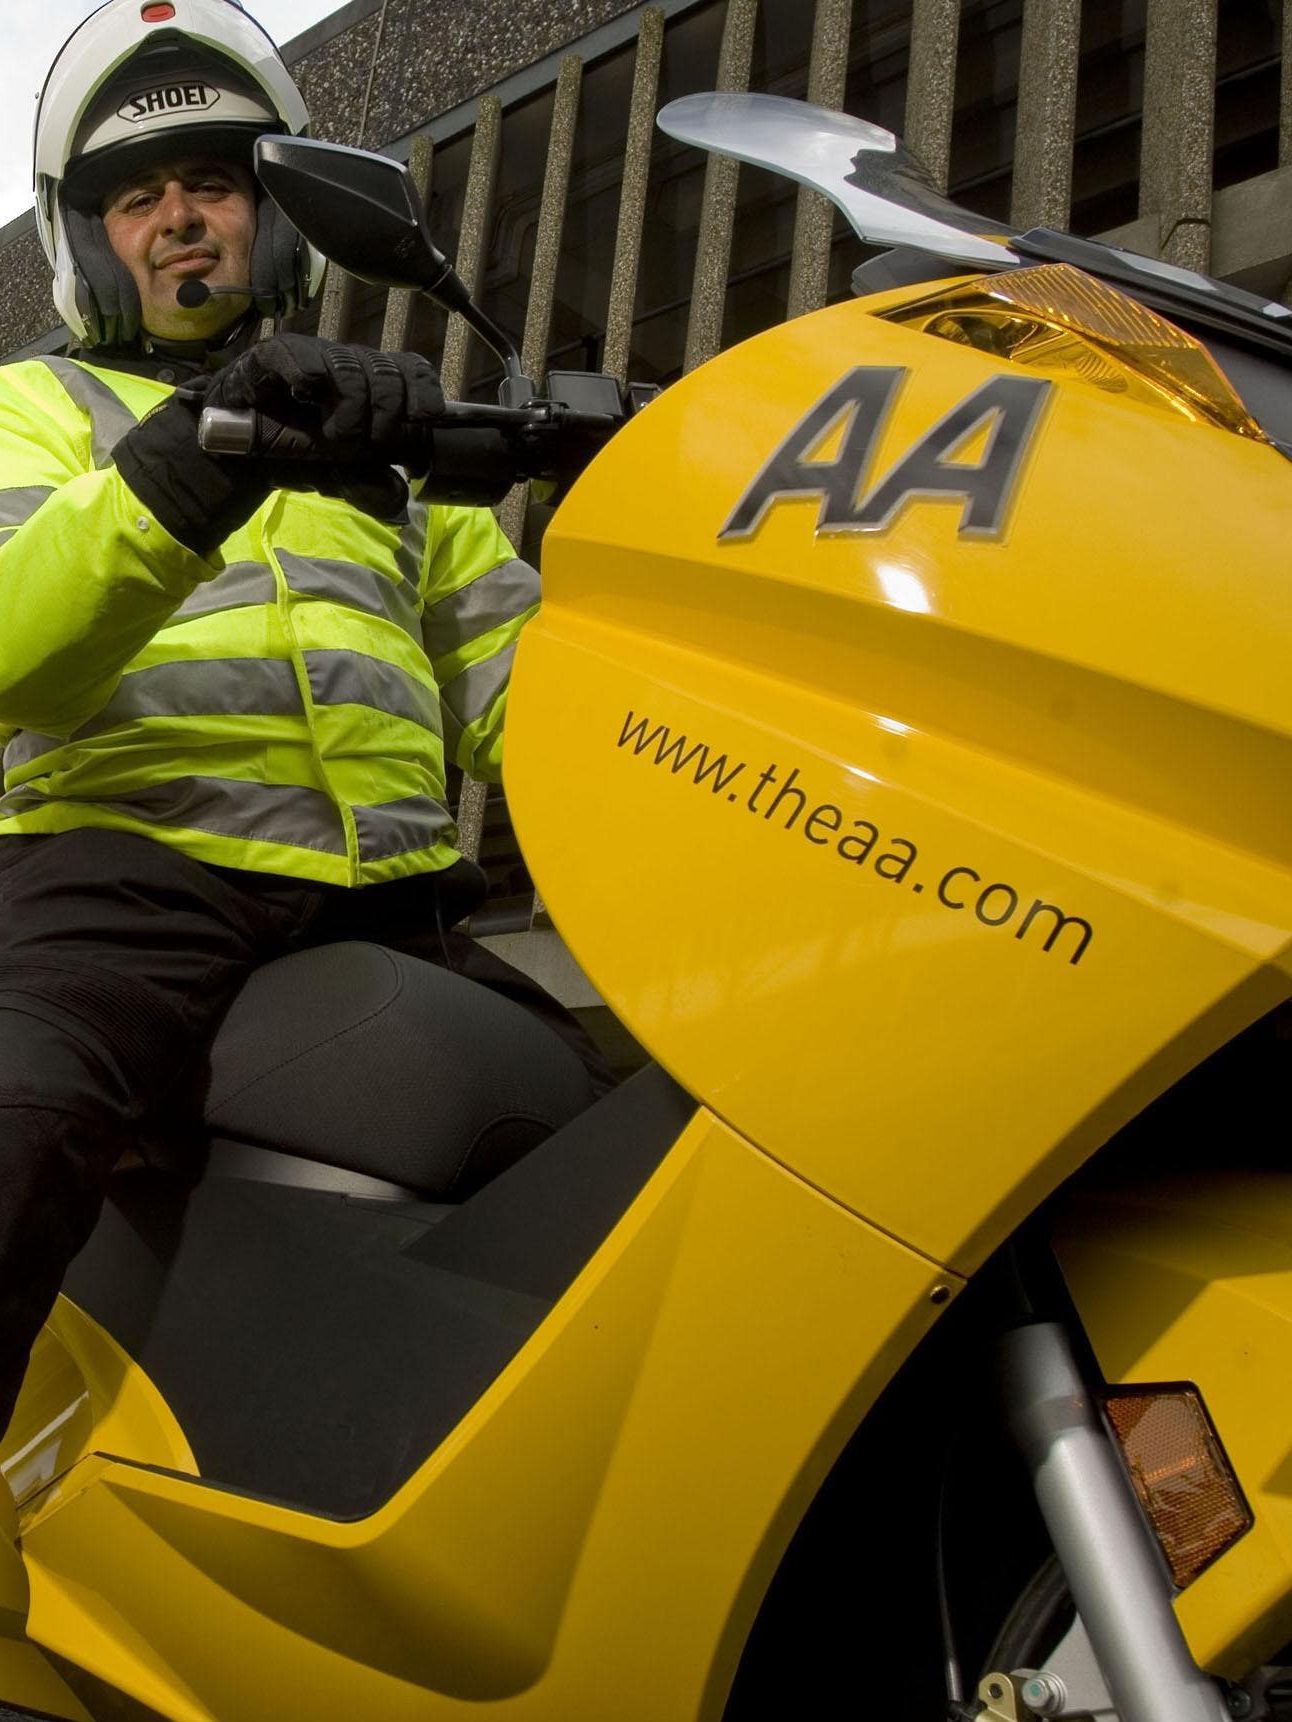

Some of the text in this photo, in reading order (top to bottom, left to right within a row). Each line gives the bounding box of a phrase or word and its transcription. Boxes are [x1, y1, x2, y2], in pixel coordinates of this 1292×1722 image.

[129, 85, 207, 117] SHOEI
[717, 365, 1052, 541] AA
[616, 710, 1094, 966] www.theaa.com
